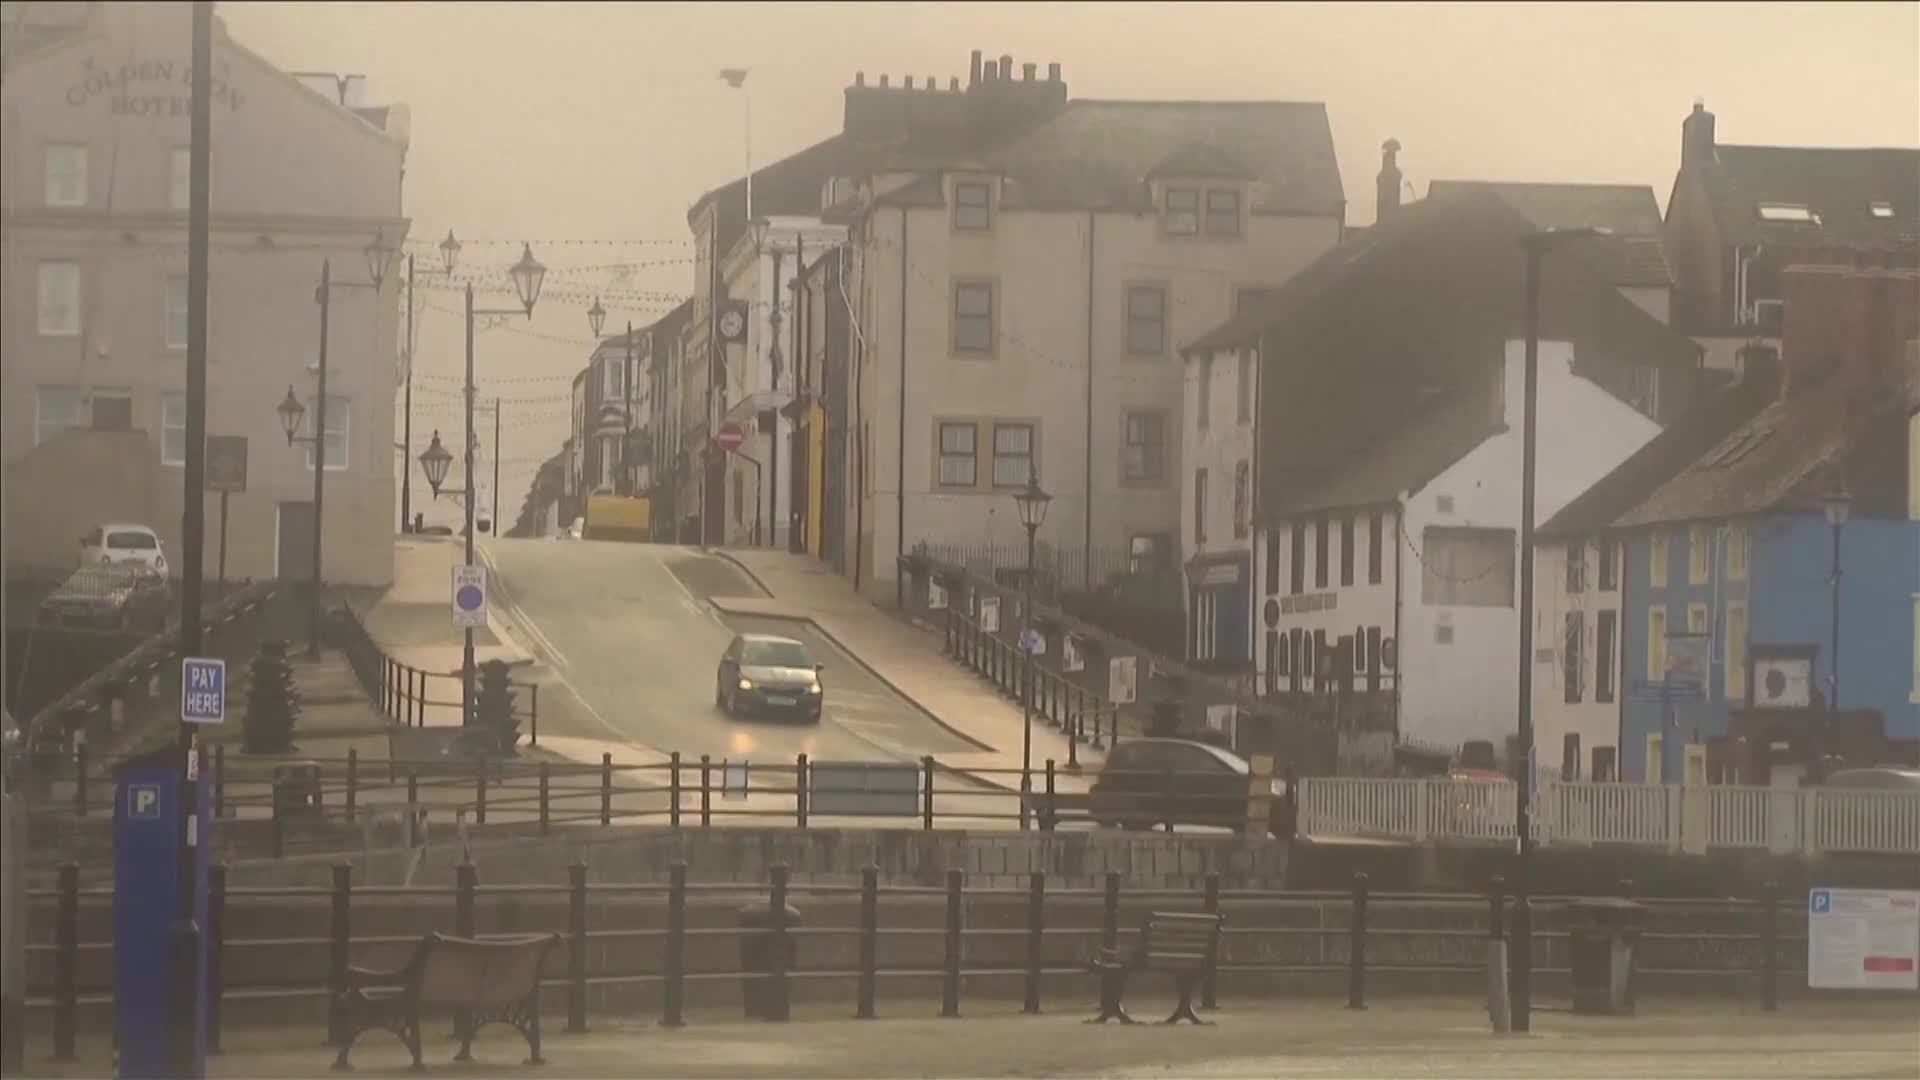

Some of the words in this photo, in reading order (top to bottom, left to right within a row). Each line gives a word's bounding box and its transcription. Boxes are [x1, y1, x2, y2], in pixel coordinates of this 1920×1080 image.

[65, 59, 174, 106] GOLDEN
[182, 67, 247, 113] LON
[191, 667, 217, 689] PAY
[186, 692, 220, 714] HERE
[137, 790, 156, 813] P
[1815, 895, 1827, 910] P
